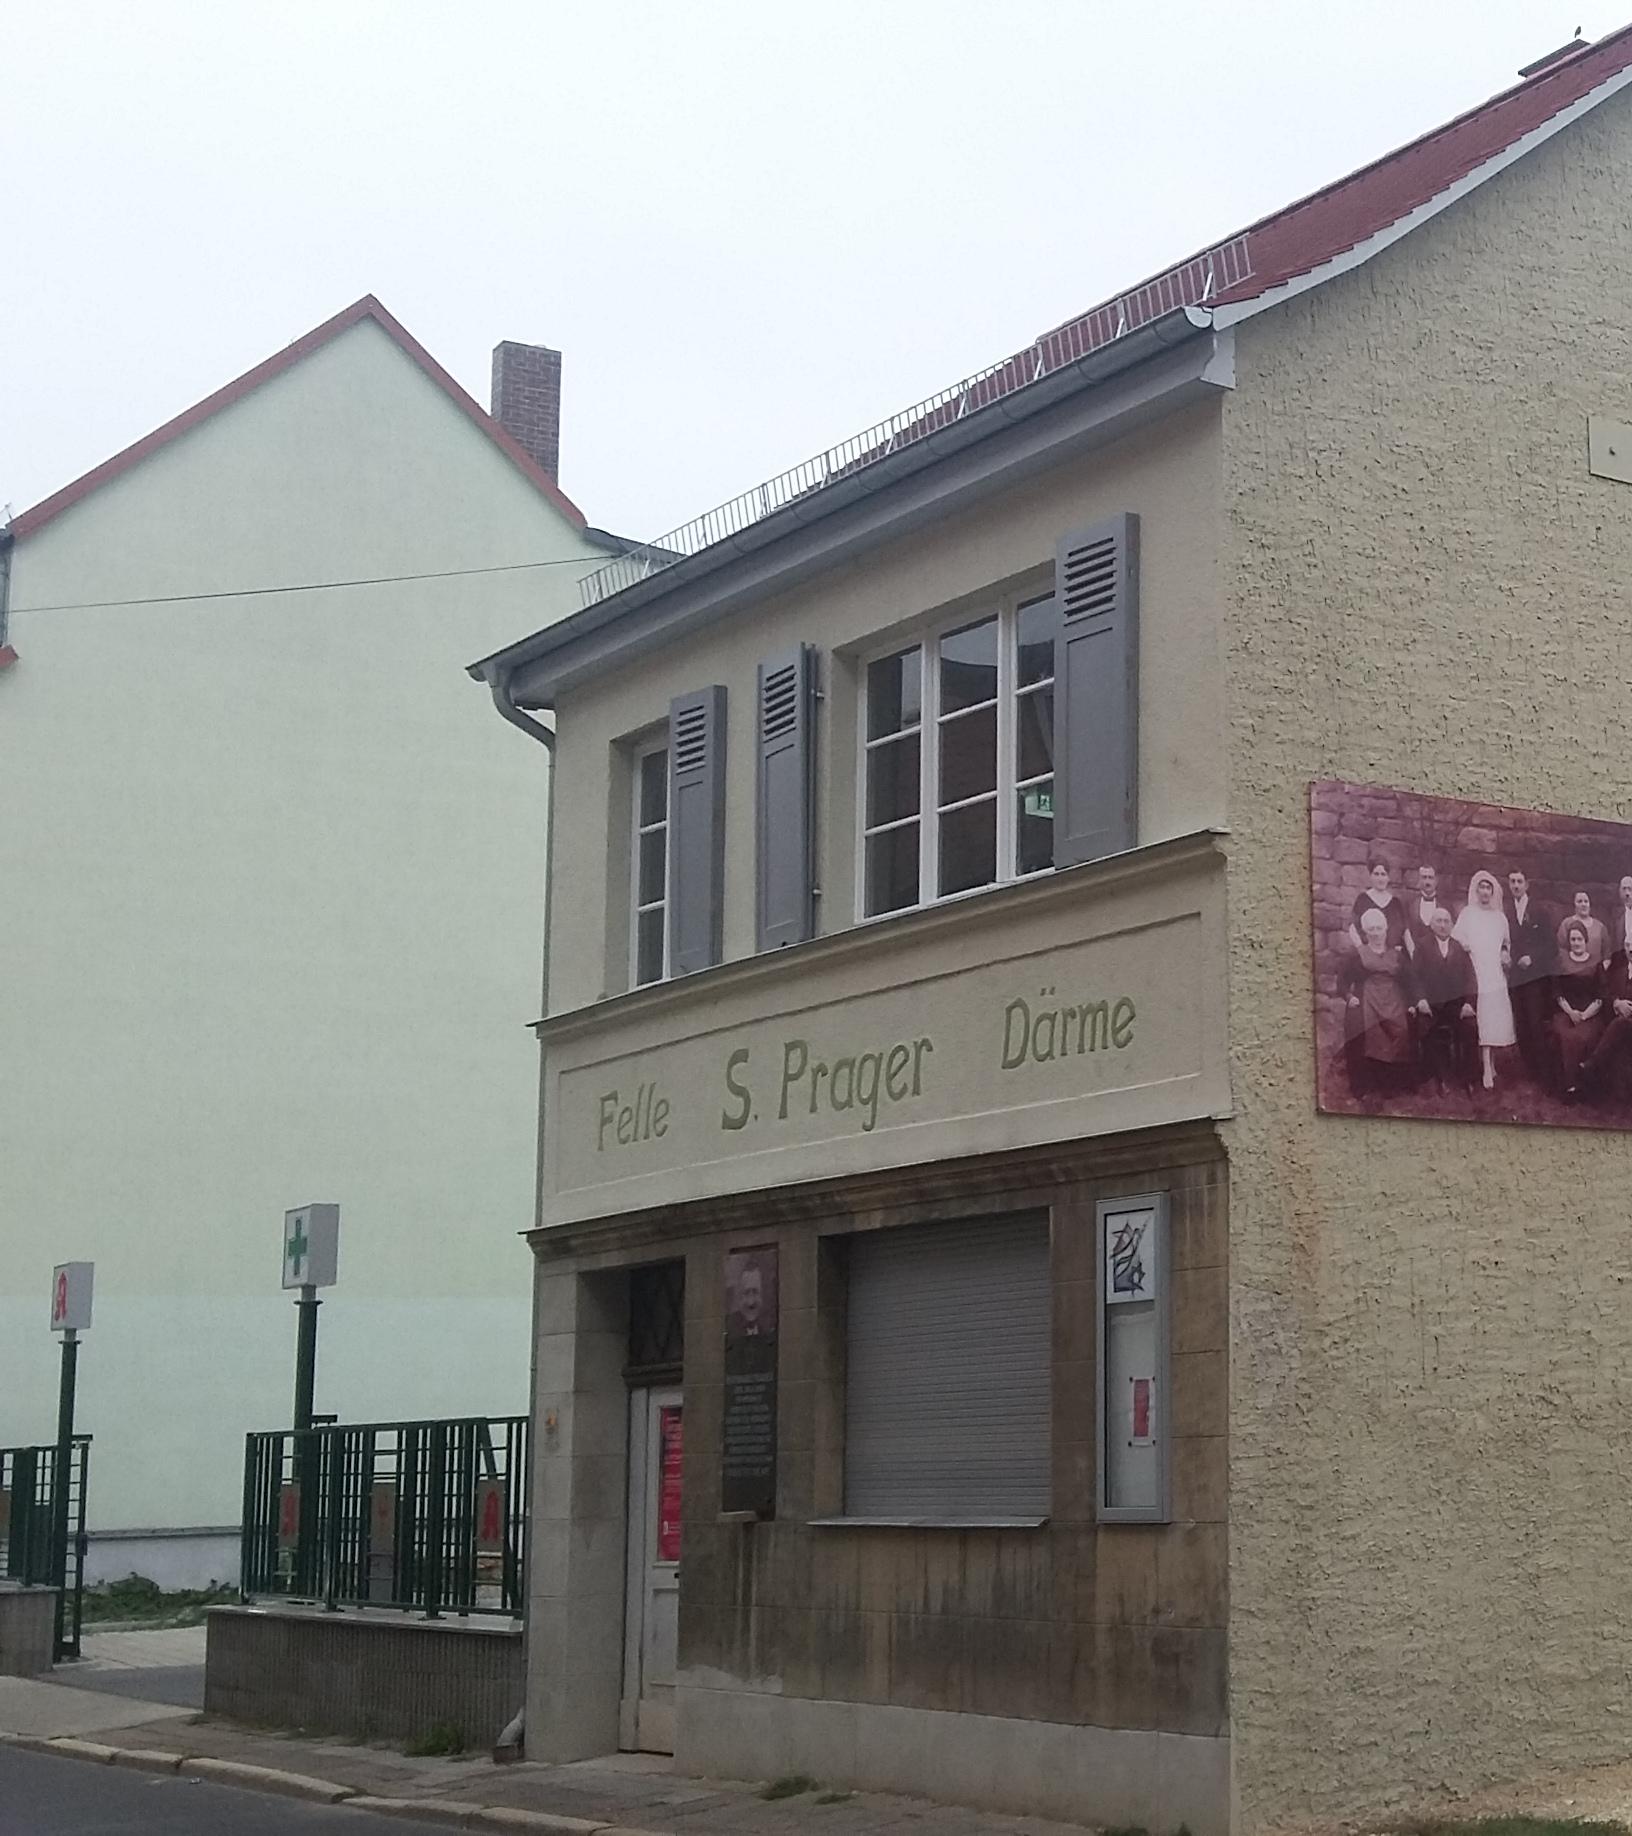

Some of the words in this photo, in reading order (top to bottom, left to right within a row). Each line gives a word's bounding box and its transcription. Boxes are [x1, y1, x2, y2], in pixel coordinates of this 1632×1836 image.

[597, 1082, 670, 1151] Felle
[721, 1048, 759, 1130] S.
[778, 1037, 934, 1132] Prager
[1001, 986, 1137, 1069] Därme
